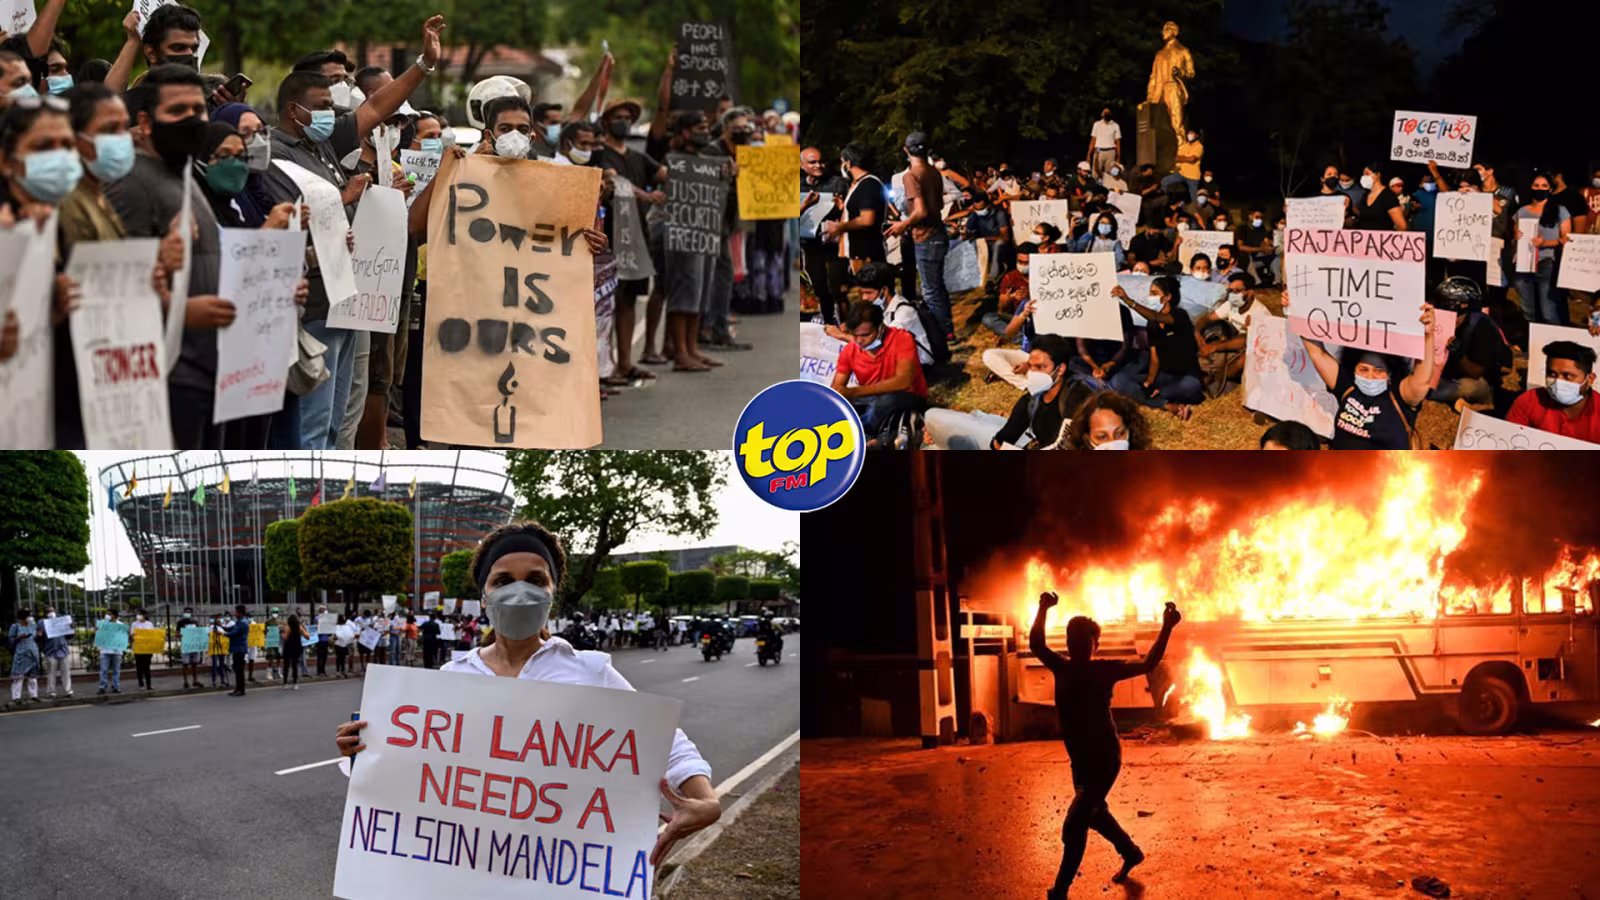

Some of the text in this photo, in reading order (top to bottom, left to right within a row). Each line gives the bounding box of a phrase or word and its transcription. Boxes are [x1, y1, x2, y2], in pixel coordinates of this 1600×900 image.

[667, 159, 687, 173] WE
[1287, 228, 1425, 263] RAJAPAKSAS
[502, 266, 554, 315] IS
[1331, 300, 1362, 318] TO
[438, 317, 571, 364] OURS
[1307, 307, 1398, 350] QUIT
[386, 705, 640, 775] SRI LANKA
[418, 763, 616, 833] NEEDS A
[350, 806, 649, 900] NELSON MANDELA
